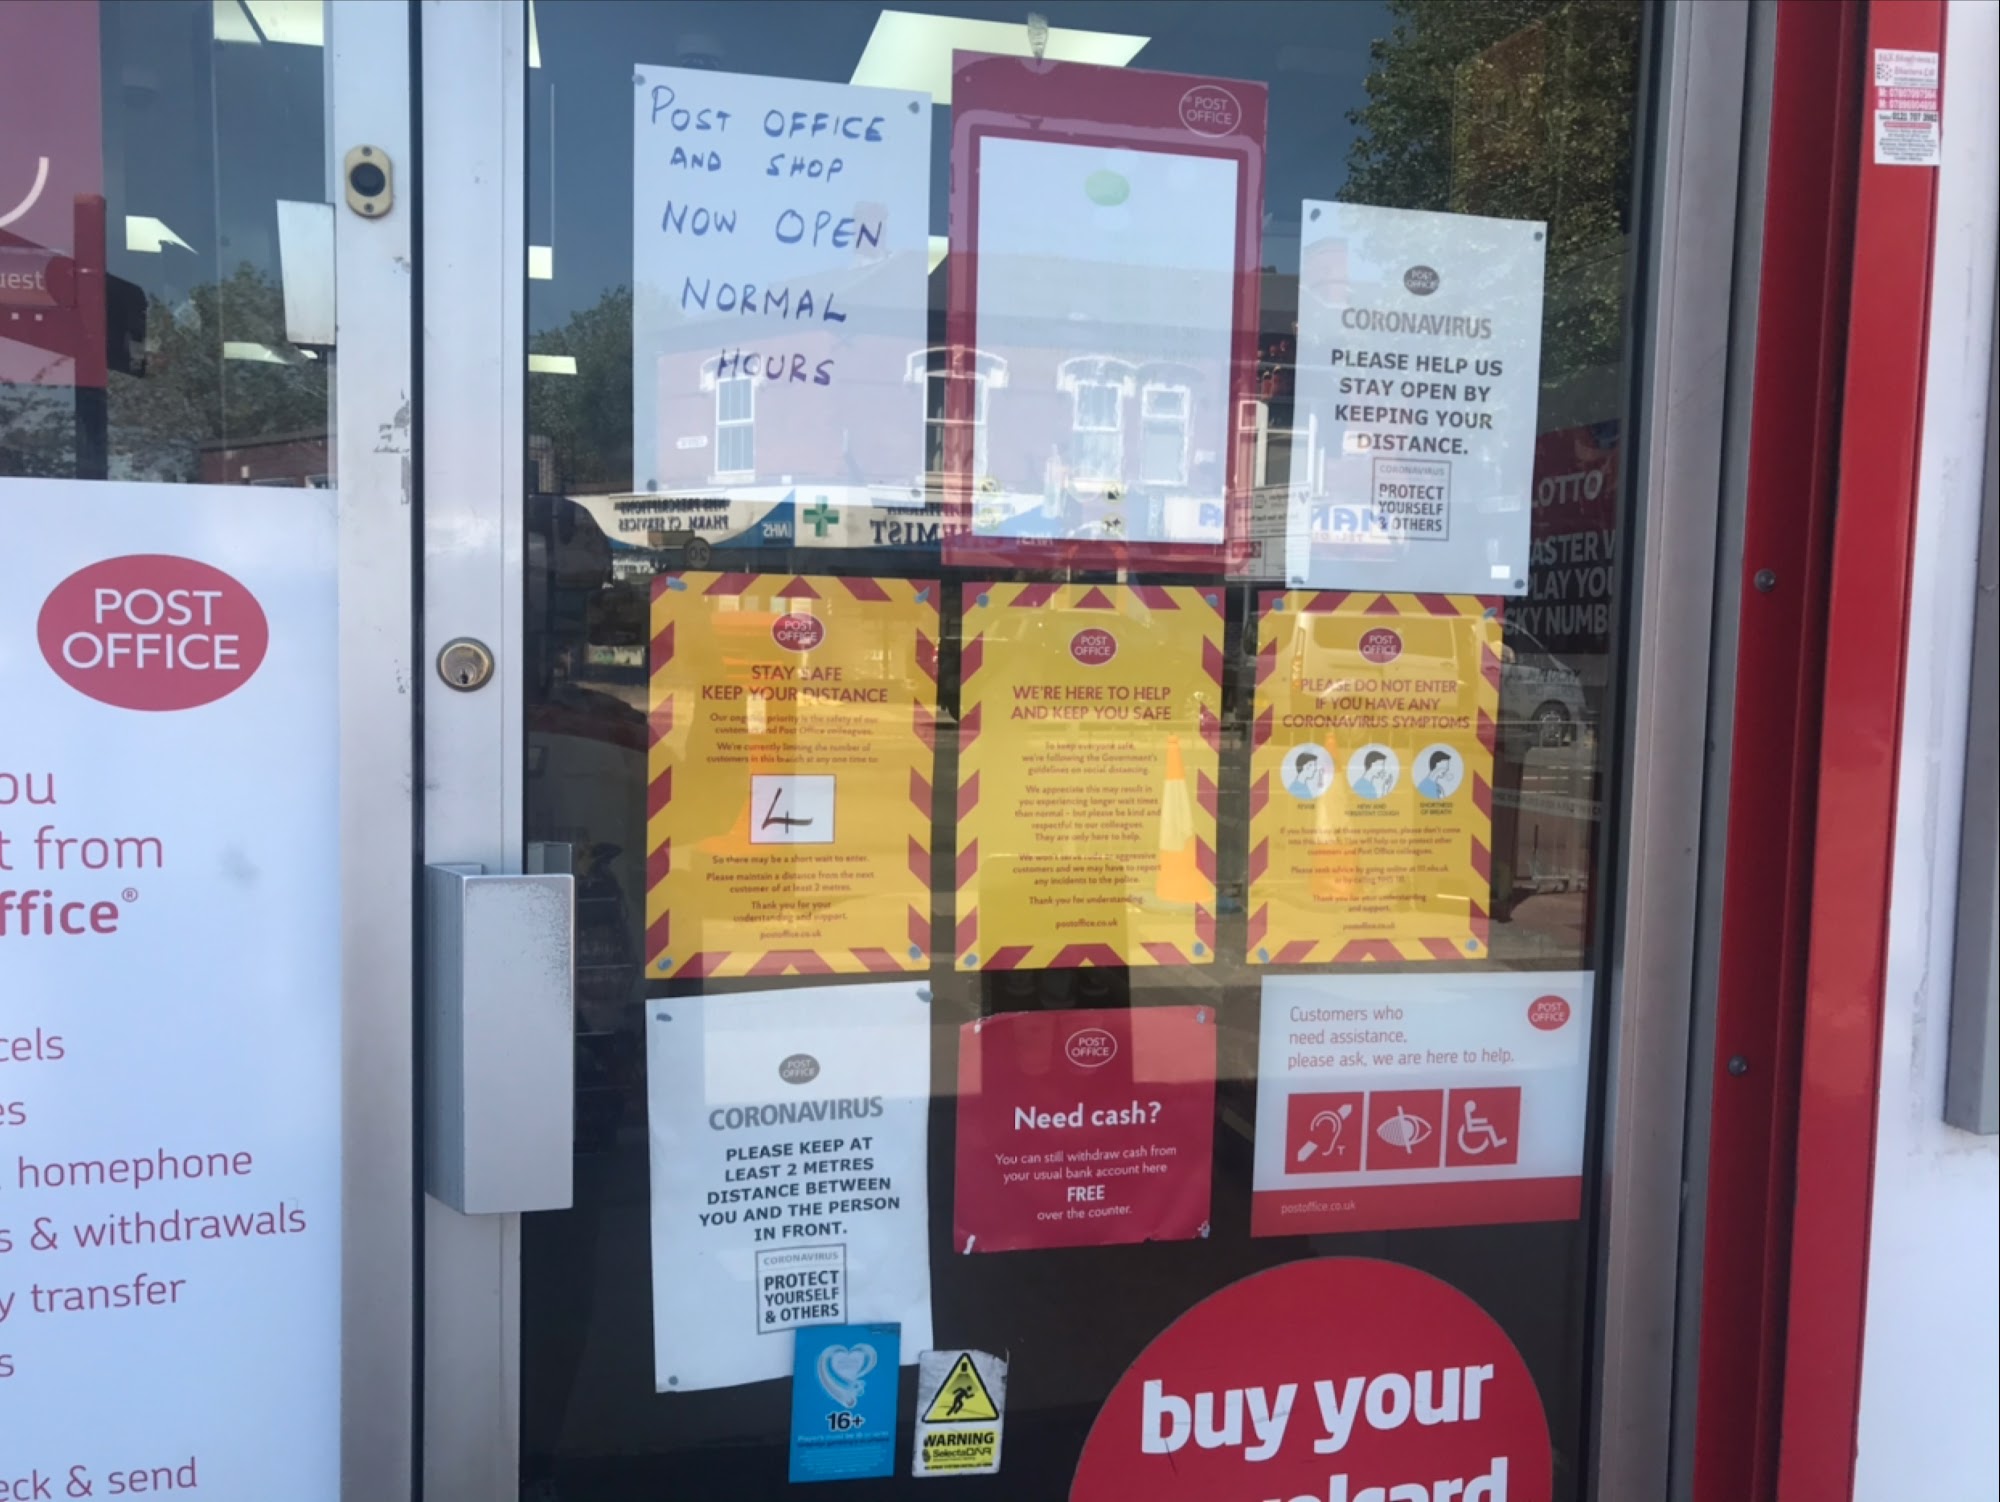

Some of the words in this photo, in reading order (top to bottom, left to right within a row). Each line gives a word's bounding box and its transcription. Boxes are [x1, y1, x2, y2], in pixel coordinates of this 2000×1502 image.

[1195, 97, 1228, 110] POST
[651, 84, 731, 132] POST
[763, 109, 885, 142] OFFICE
[1187, 109, 1232, 124] OFFICE
[670, 146, 722, 171] AND
[766, 153, 844, 183] SHOP
[662, 200, 737, 236] NOW
[775, 209, 882, 249] OPEN
[681, 276, 847, 322] NORMAL
[1342, 307, 1492, 339] CORONAVIRUS
[717, 348, 834, 386] HOURS
[1331, 349, 1408, 370] PLEASE
[1416, 356, 1467, 374] HELP
[1475, 360, 1503, 376] US
[1339, 377, 1394, 396] STAY
[1401, 381, 1456, 400] OPEN
[1464, 386, 1490, 401] BY
[1335, 405, 1428, 425] KEEPING
[1436, 411, 1492, 428] YOUR
[1357, 433, 1468, 454] DISTANCE.
[1380, 464, 1445, 476] CORONAVIRUS
[1379, 483, 1444, 499] PROTECT
[1532, 470, 1603, 509] OTTO
[1379, 501, 1443, 515] YOURSELF
[1392, 517, 1442, 531] OTHERS
[95, 587, 223, 626] POST
[784, 620, 813, 630] POST
[1081, 636, 1106, 645] POST
[1369, 635, 1393, 644] POST
[62, 631, 240, 670] OFFICE
[1075, 647, 1110, 656] OFFICE
[1363, 645, 1398, 654] OFFICE
[752, 666, 796, 680] STAY
[702, 686, 742, 700] KEEP
[749, 686, 796, 700] YOUR
[802, 688, 888, 703] DISTANCE
[1012, 686, 1061, 699] WE'RE
[1066, 686, 1102, 699] HERE
[1109, 687, 1129, 699] TO
[1134, 687, 1171, 699] HELP
[1301, 679, 1351, 692] PLEASE
[1355, 679, 1377, 692] DO
[1381, 680, 1411, 692] NOT
[1415, 680, 1457, 692] ENTER
[1315, 698, 1325, 709] IF
[1331, 697, 1362, 710] YOU
[1366, 698, 1405, 710] HAVE
[1408, 698, 1440, 710] ANY
[1011, 706, 1048, 720] AND
[1053, 706, 1089, 720] KEEP
[1093, 706, 1128, 719] YOU
[1133, 706, 1171, 720] SAFE
[1282, 715, 1388, 728] CORONAVIRUS
[1392, 716, 1470, 729] SYMPTOMS
[762, 788, 813, 834] 4
[1035, 833, 1053, 842] They
[34, 825, 162, 871] from
[712, 856, 724, 864] So
[726, 855, 748, 864] there
[750, 856, 768, 866] may
[771, 855, 782, 863] be
[790, 854, 813, 863] short
[817, 855, 834, 863] wait
[706, 872, 734, 881] Please
[736, 872, 772, 880] maintain
[782, 872, 816, 880] distance
[818, 872, 838, 880] from
[840, 871, 853, 879] the
[856, 871, 874, 879] next
[1290, 1006, 1368, 1022] Customers
[1373, 1006, 1403, 1020] who
[1538, 1003, 1562, 1012] POST
[1531, 1012, 1565, 1022] OFFICE
[1079, 1037, 1106, 1046] POST
[1289, 1030, 1324, 1044] need
[1072, 1047, 1109, 1056] OFFICE
[1288, 1053, 1334, 1070] please
[1373, 1054, 1393, 1066] we
[1398, 1053, 1422, 1065] are
[1426, 1049, 1458, 1064] here
[1463, 1049, 1477, 1063] to
[1482, 1048, 1514, 1065] help.
[783, 1067, 815, 1078] OFFICE
[787, 1060, 811, 1069] POST
[709, 1096, 883, 1131] CORONAVIRUS
[1015, 1102, 1083, 1130] Need
[1091, 1101, 1161, 1126] cash?
[726, 1144, 793, 1161] PLEASE
[800, 1139, 844, 1155] KEEP
[850, 1137, 873, 1150] AT
[995, 1153, 1017, 1165] You
[1021, 1153, 1041, 1164] can
[1044, 1151, 1063, 1162] still
[1067, 1149, 1120, 1162] withdraw
[1123, 1147, 1147, 1158] cash
[1150, 1145, 1176, 1156] from
[18, 1148, 252, 1189] homephone
[725, 1165, 780, 1182] LEAST
[787, 1164, 797, 1176] 2
[804, 1158, 874, 1175] METRES
[1003, 1172, 1029, 1184] your
[1034, 1169, 1062, 1180] usual
[1066, 1168, 1092, 1178] bank
[1097, 1165, 1139, 1176] account
[1142, 1163, 1167, 1173] here
[707, 1183, 799, 1205] DISTANCE
[806, 1178, 891, 1195] BETWEEN
[1067, 1185, 1105, 1202] FREE
[699, 1212, 737, 1226] YOU
[743, 1206, 782, 1222] AND
[788, 1203, 822, 1217] THE
[829, 1197, 899, 1214] PERSON
[1037, 1210, 1063, 1220] over
[1067, 1208, 1084, 1218] the
[1088, 1205, 1132, 1217] counter.
[1281, 1201, 1356, 1215] postoffice.co.uk
[30, 1217, 57, 1250] &
[74, 1201, 307, 1248] withdrawals
[754, 1226, 775, 1241] IN
[783, 1221, 847, 1239] FRONT.
[764, 1251, 838, 1265] CORONAVIRUS
[764, 1270, 839, 1290] PROTECT
[31, 1273, 186, 1312] transfer
[765, 1287, 839, 1306] YOURSELF
[765, 1310, 776, 1323] &
[780, 1303, 839, 1321] OTHERS
[825, 1411, 865, 1431] 16+
[1141, 1379, 1298, 1462] buy
[1313, 1363, 1494, 1454] your
[924, 1432, 994, 1447] WARNING
[66, 1465, 92, 1498] &
[108, 1456, 198, 1494] send
